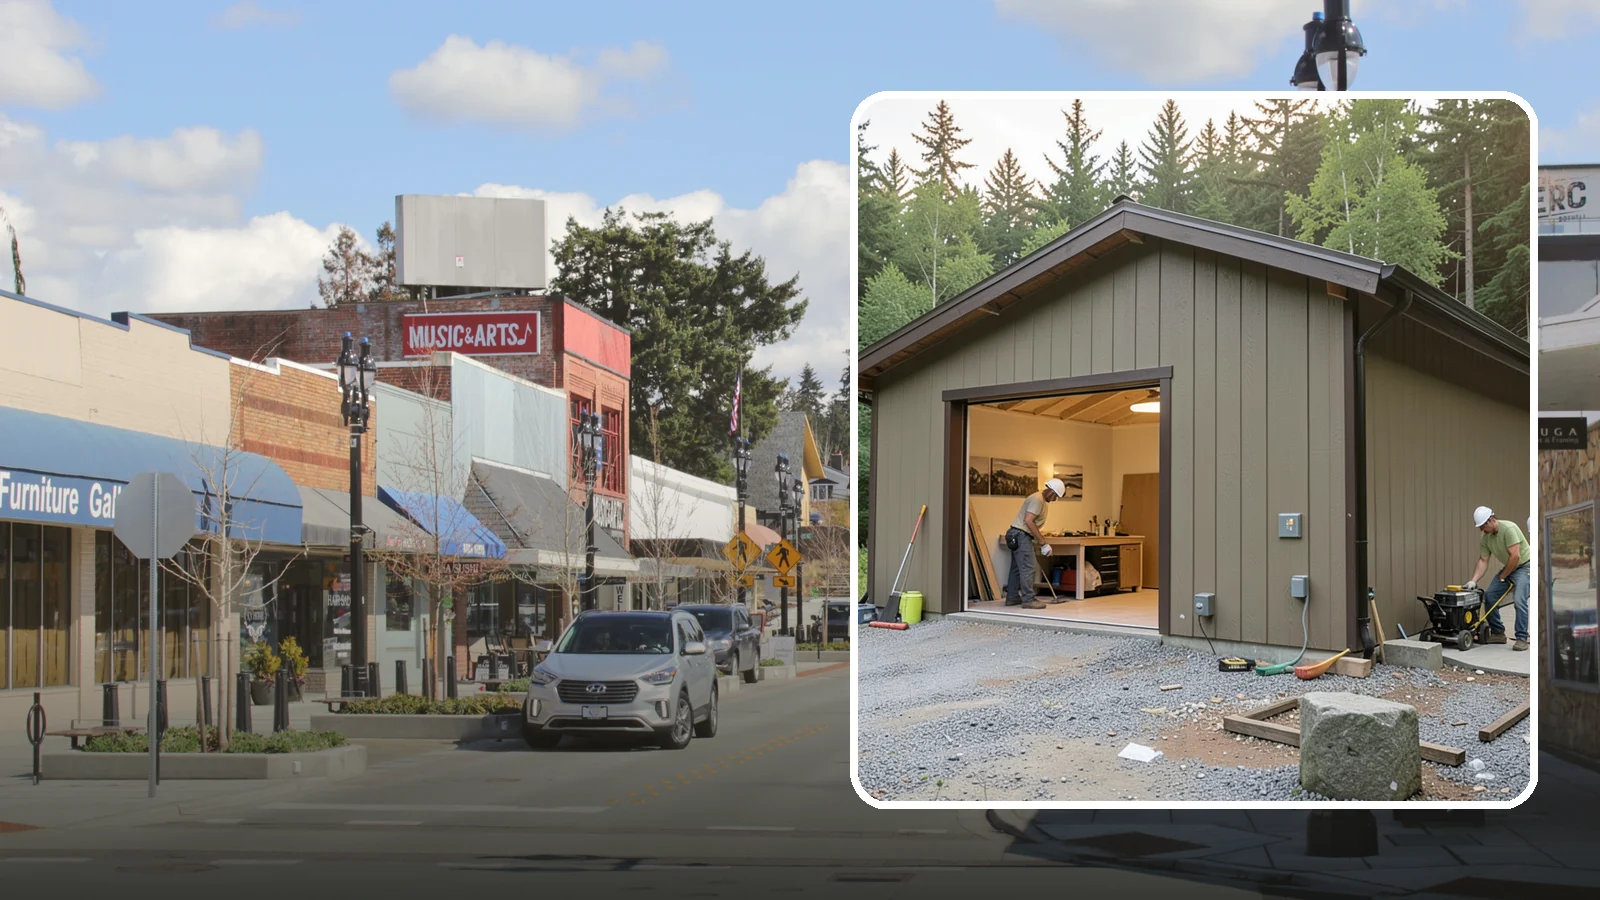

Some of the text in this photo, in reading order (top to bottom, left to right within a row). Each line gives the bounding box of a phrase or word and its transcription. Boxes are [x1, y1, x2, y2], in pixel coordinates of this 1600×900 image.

[1540, 427, 1578, 437] UGA
[0, 471, 80, 515] Furniture
[453, 562, 479, 574] SUSHI
